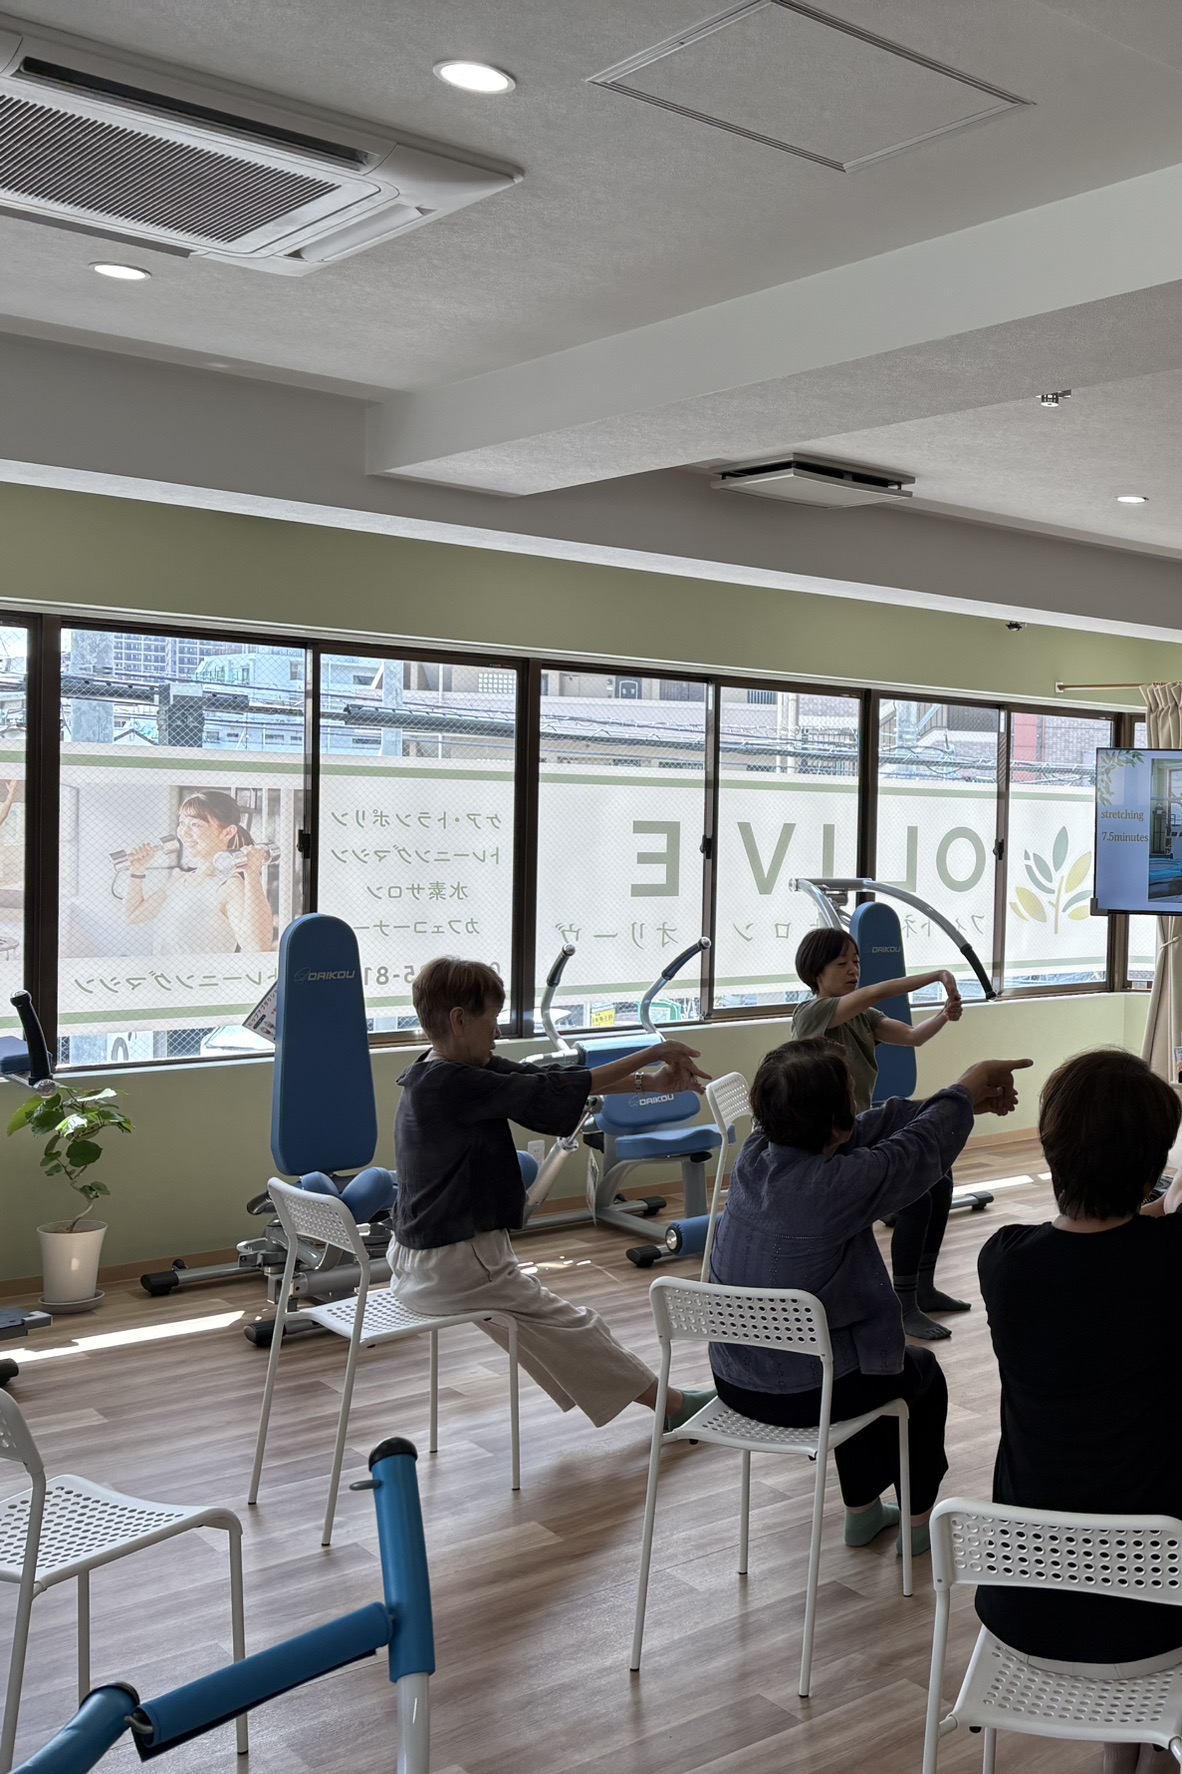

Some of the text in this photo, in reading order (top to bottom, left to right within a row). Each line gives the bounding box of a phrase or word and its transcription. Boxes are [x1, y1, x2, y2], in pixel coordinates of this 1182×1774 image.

[1101, 810, 1144, 821] stretching
[1101, 831, 1149, 842] 7.5minutes
[307, 970, 356, 981] DAIKOU
[638, 1093, 675, 1107] DAIKOU
